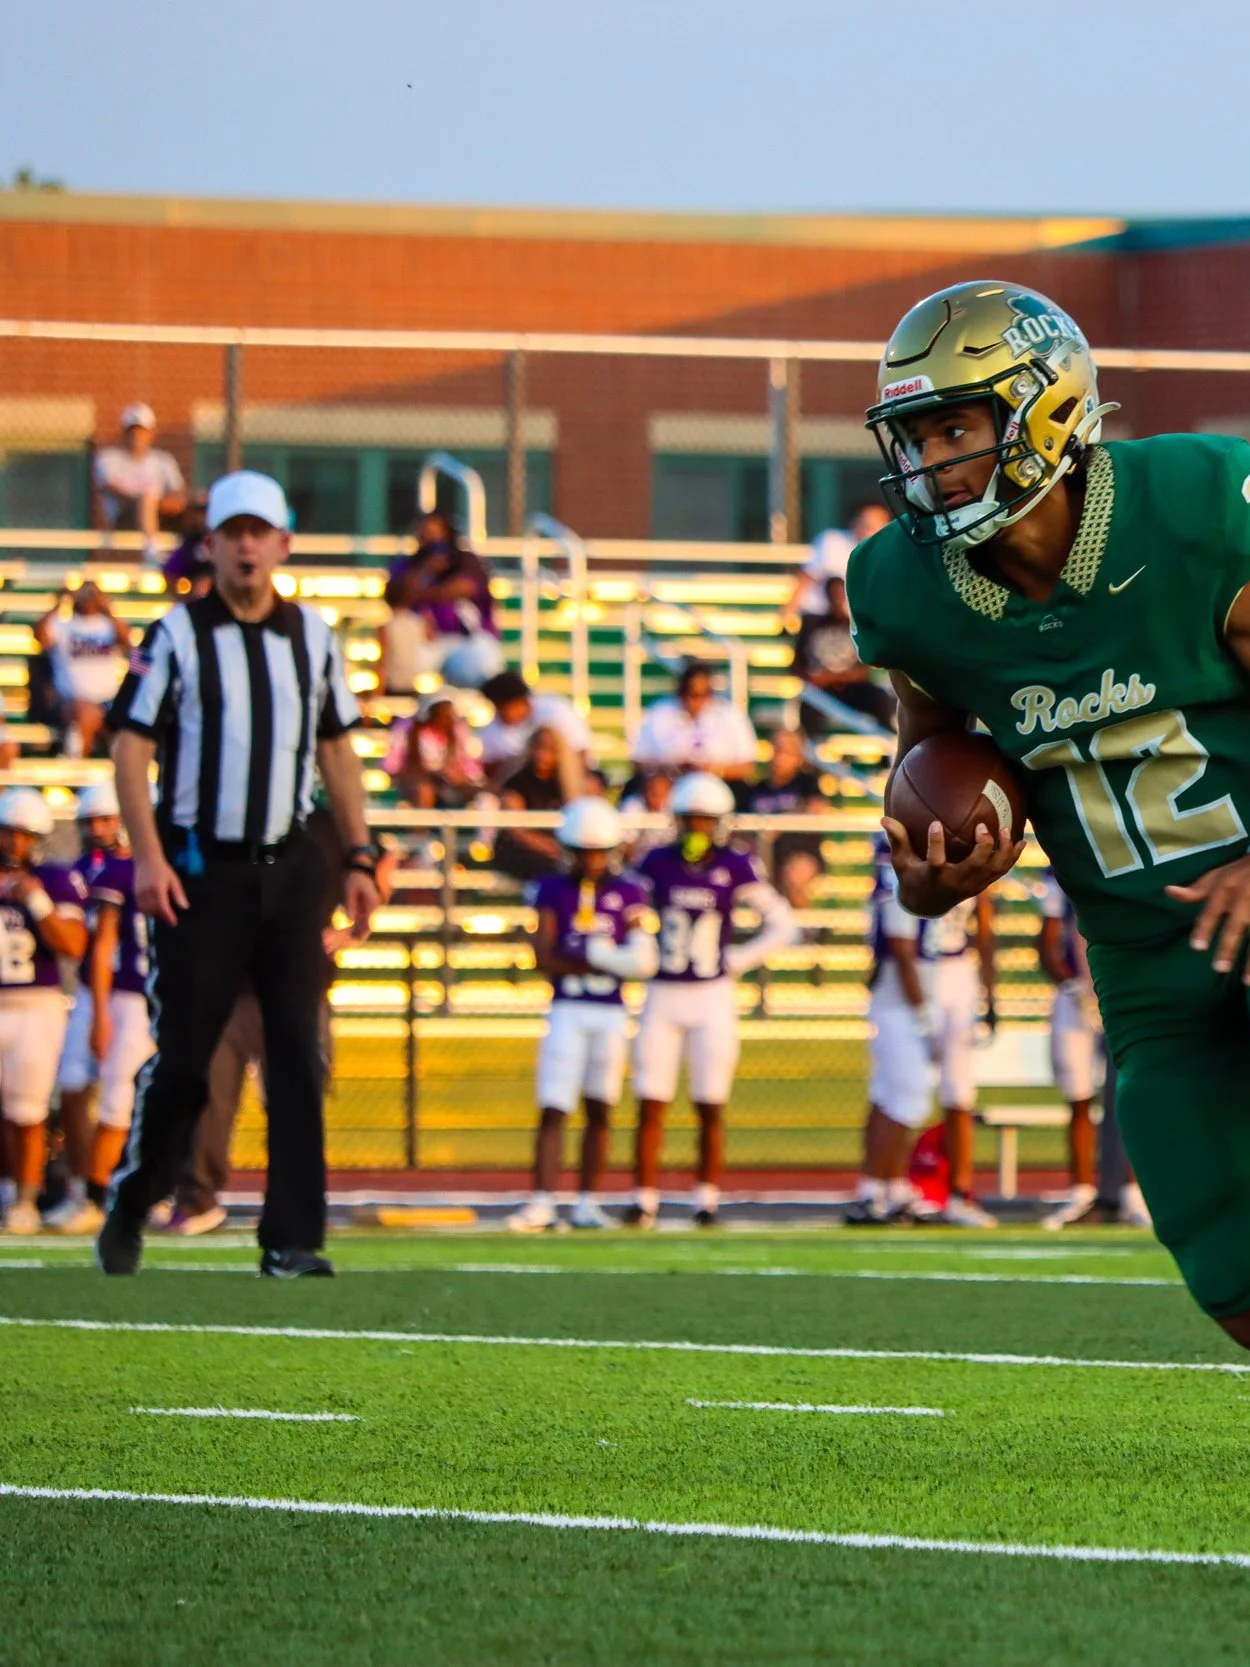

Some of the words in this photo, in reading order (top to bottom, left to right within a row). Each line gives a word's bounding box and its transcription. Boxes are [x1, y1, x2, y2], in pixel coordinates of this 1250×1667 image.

[883, 379, 923, 400] Riddell
[1010, 668, 1157, 735] Rocks
[1020, 708, 1249, 879] 12
